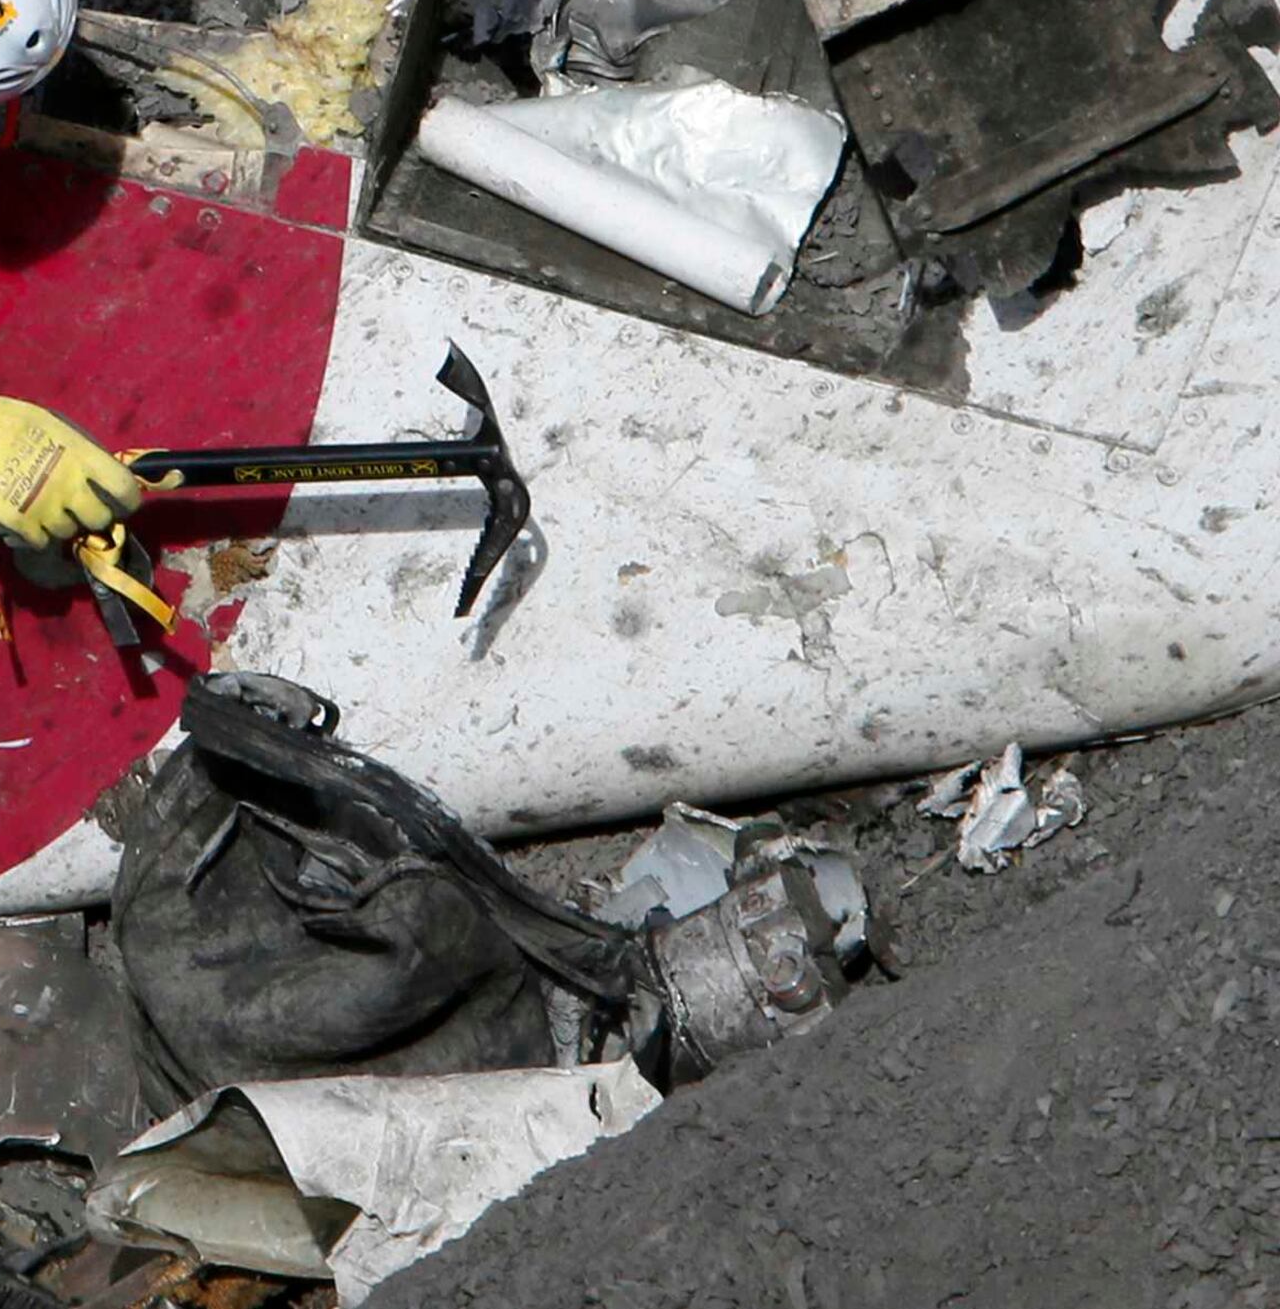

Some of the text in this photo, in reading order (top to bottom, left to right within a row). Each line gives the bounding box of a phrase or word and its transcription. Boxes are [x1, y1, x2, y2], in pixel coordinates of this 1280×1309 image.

[271, 464, 404, 480] GRIVEL MONT BLANC
